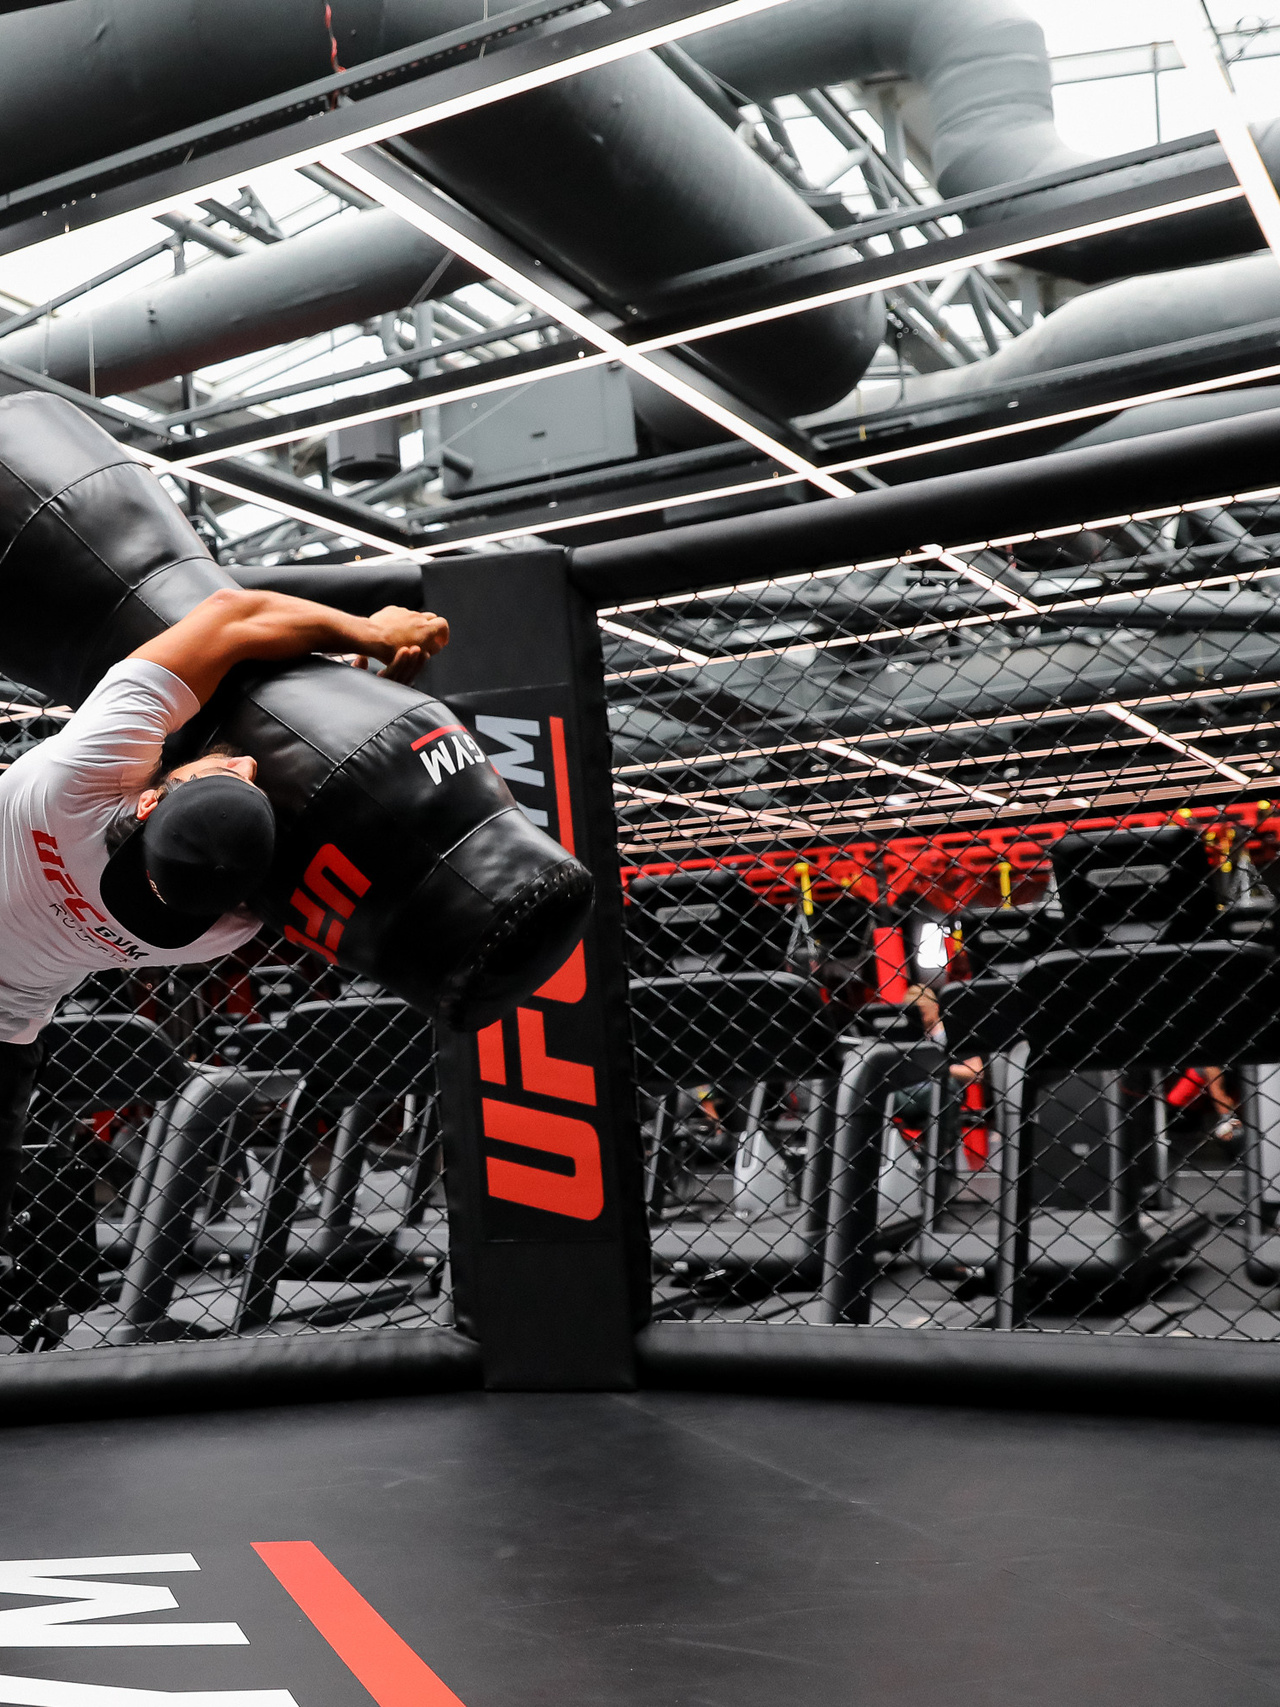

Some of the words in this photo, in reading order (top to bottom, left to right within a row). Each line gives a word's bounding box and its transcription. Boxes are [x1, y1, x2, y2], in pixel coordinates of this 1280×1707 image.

[419, 734, 486, 785] GYM
[32, 830, 107, 922] UFC
[95, 926, 150, 960] GYM
